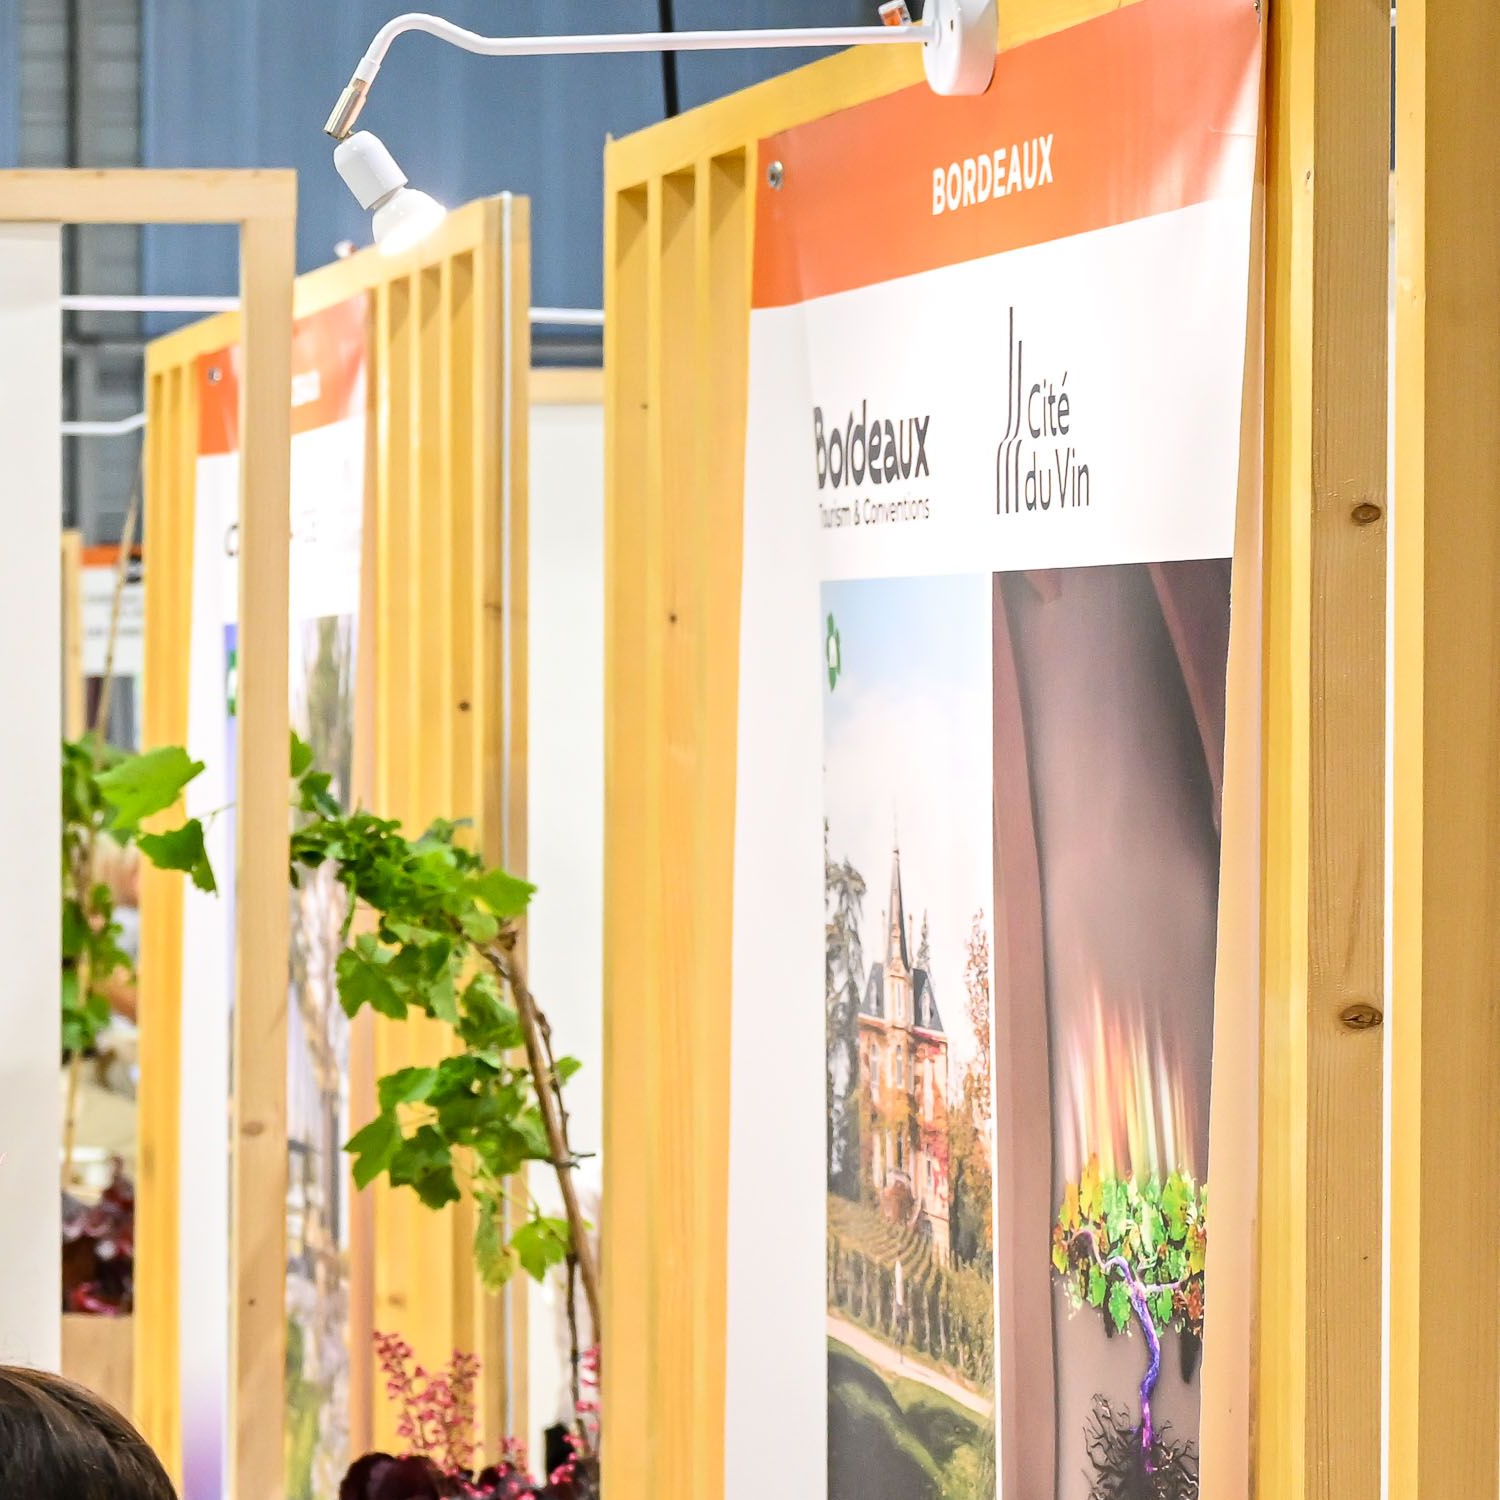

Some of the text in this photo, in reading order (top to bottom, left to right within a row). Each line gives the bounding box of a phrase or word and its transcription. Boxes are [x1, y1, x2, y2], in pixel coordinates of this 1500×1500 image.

[932, 134, 1054, 216] BORDEAUX
[814, 399, 930, 489] Bordeaux
[1028, 371, 1070, 439] Cité
